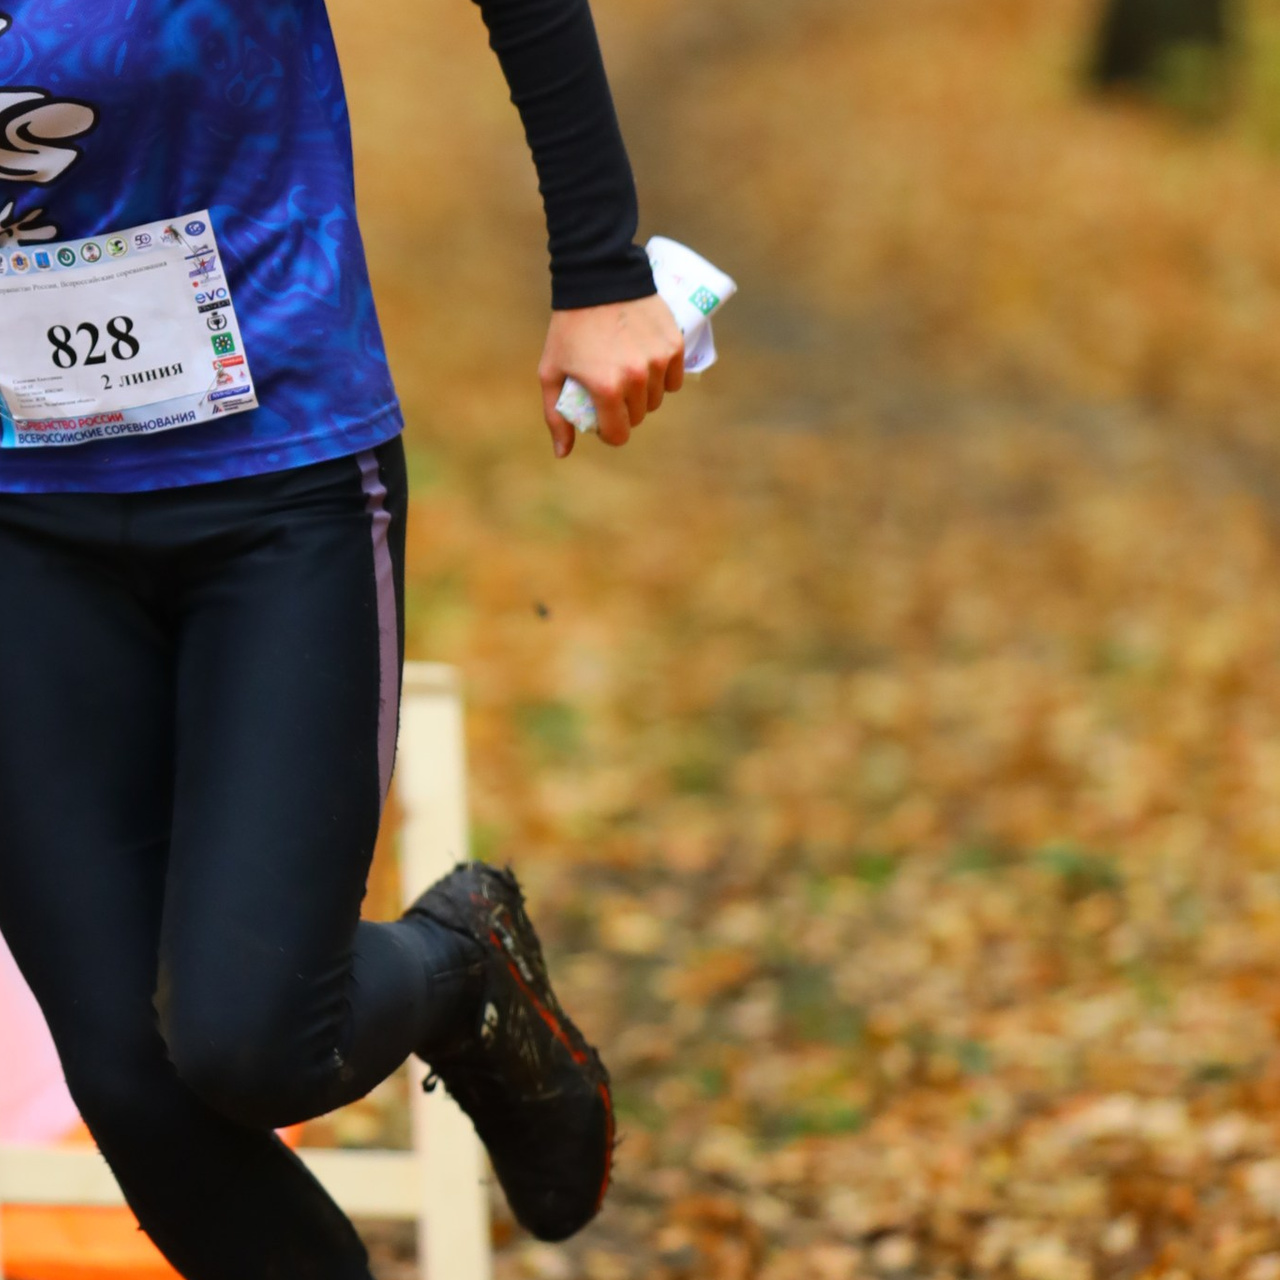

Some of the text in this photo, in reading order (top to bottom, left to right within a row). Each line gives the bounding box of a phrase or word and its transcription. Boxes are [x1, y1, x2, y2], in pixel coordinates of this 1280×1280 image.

[195, 287, 227, 304] evo
[47, 315, 140, 369] 828
[101, 374, 112, 390] 2
[78, 412, 124, 428] РОССИИ
[104, 410, 196, 435] СОРЕВНОВАНИЯ
